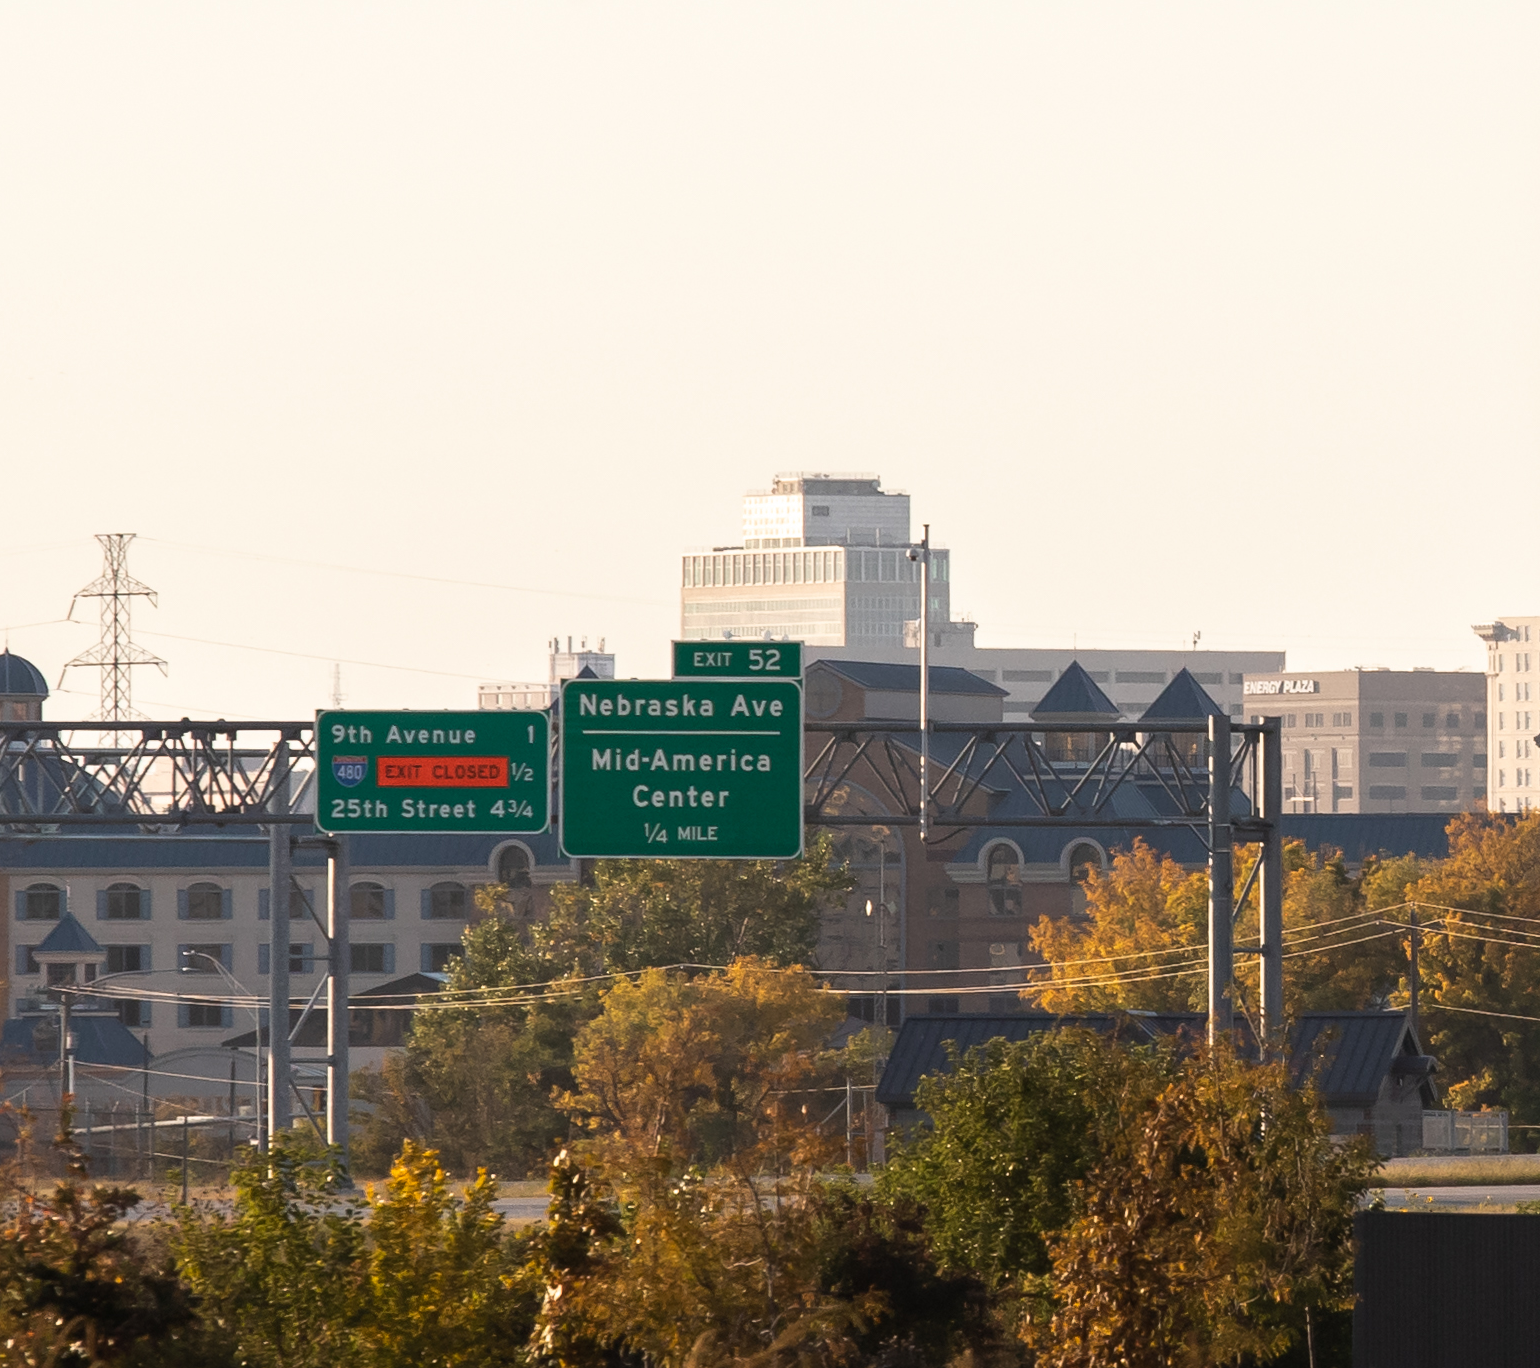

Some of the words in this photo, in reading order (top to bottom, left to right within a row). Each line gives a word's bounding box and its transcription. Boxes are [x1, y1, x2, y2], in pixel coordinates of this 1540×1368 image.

[693, 652, 733, 667] EXIT
[749, 649, 781, 671] 52
[1243, 680, 1282, 695] ENERGY
[1283, 679, 1315, 694] PLAZA
[579, 694, 714, 717] Nebraska
[730, 694, 783, 717] Ave
[331, 725, 372, 744] 9th
[385, 725, 476, 744] Avenue
[527, 725, 534, 744] 1
[592, 748, 771, 772] Mid-America
[337, 765, 362, 780] 480
[385, 765, 422, 780] EXIT
[432, 764, 501, 780] CLOSED
[633, 784, 730, 808] Center
[331, 799, 388, 818] 25th
[401, 799, 476, 818] Street
[677, 826, 718, 841] MILE
